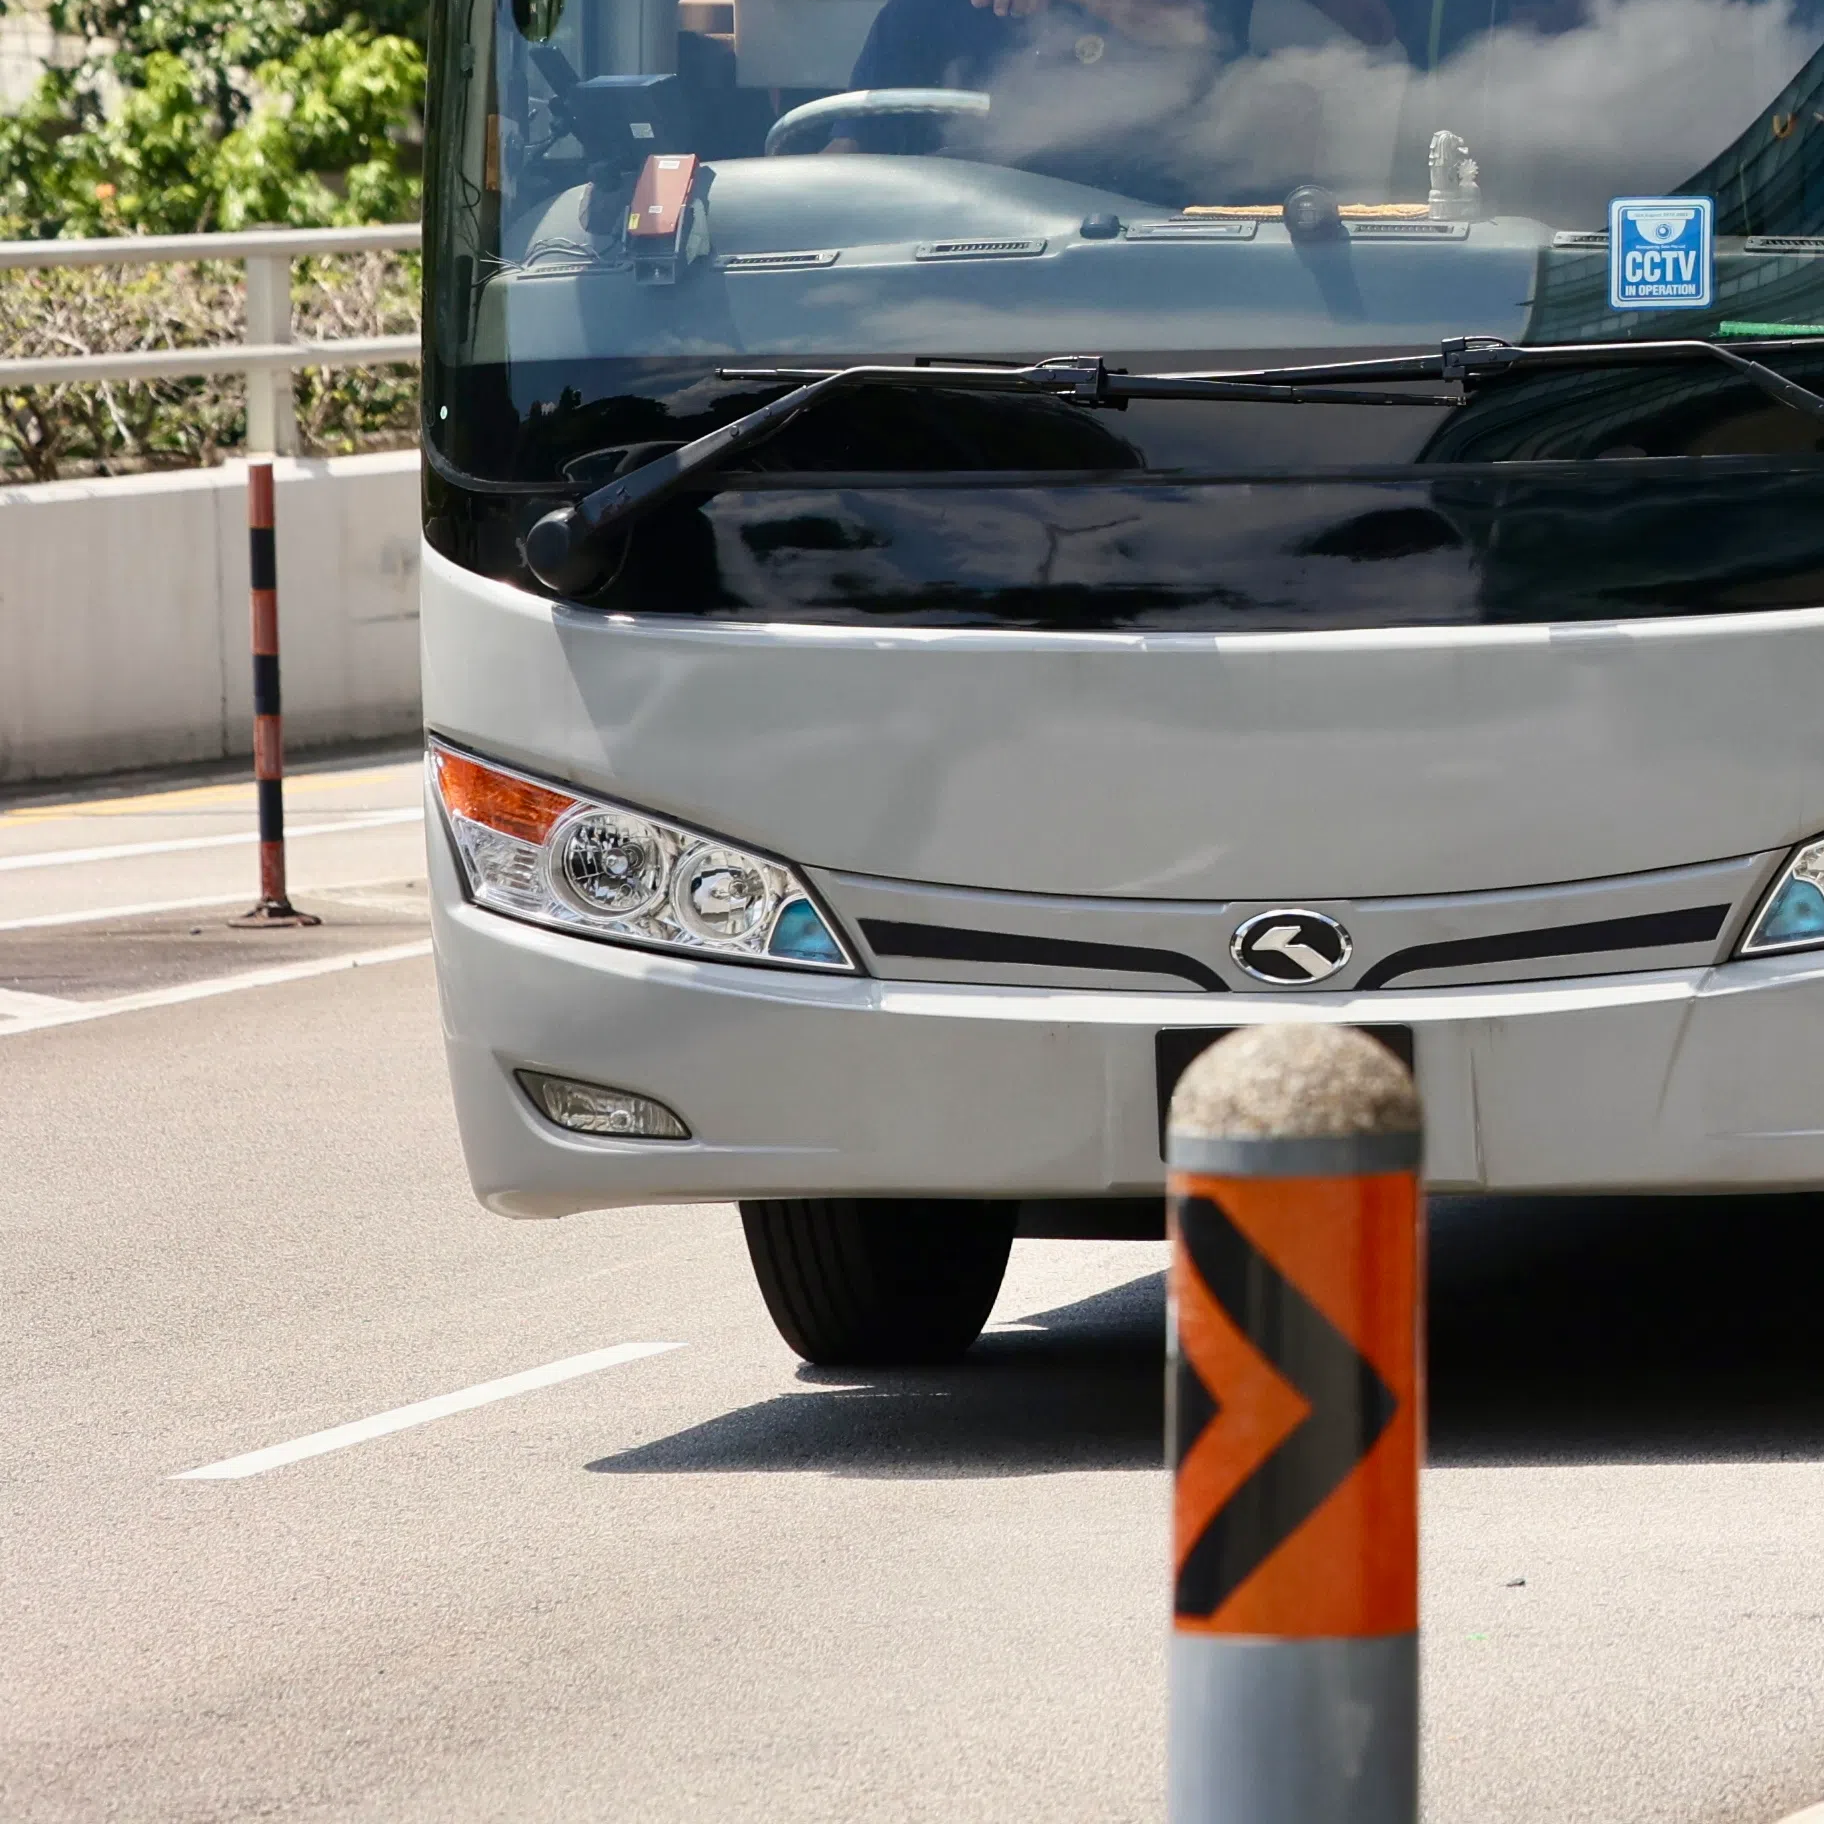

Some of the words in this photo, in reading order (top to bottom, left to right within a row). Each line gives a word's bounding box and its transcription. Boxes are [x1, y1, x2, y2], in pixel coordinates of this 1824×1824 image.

[1625, 250, 1697, 283] CCTV
[1625, 285, 1636, 296] IN
[1638, 284, 1696, 296] OPERATION
